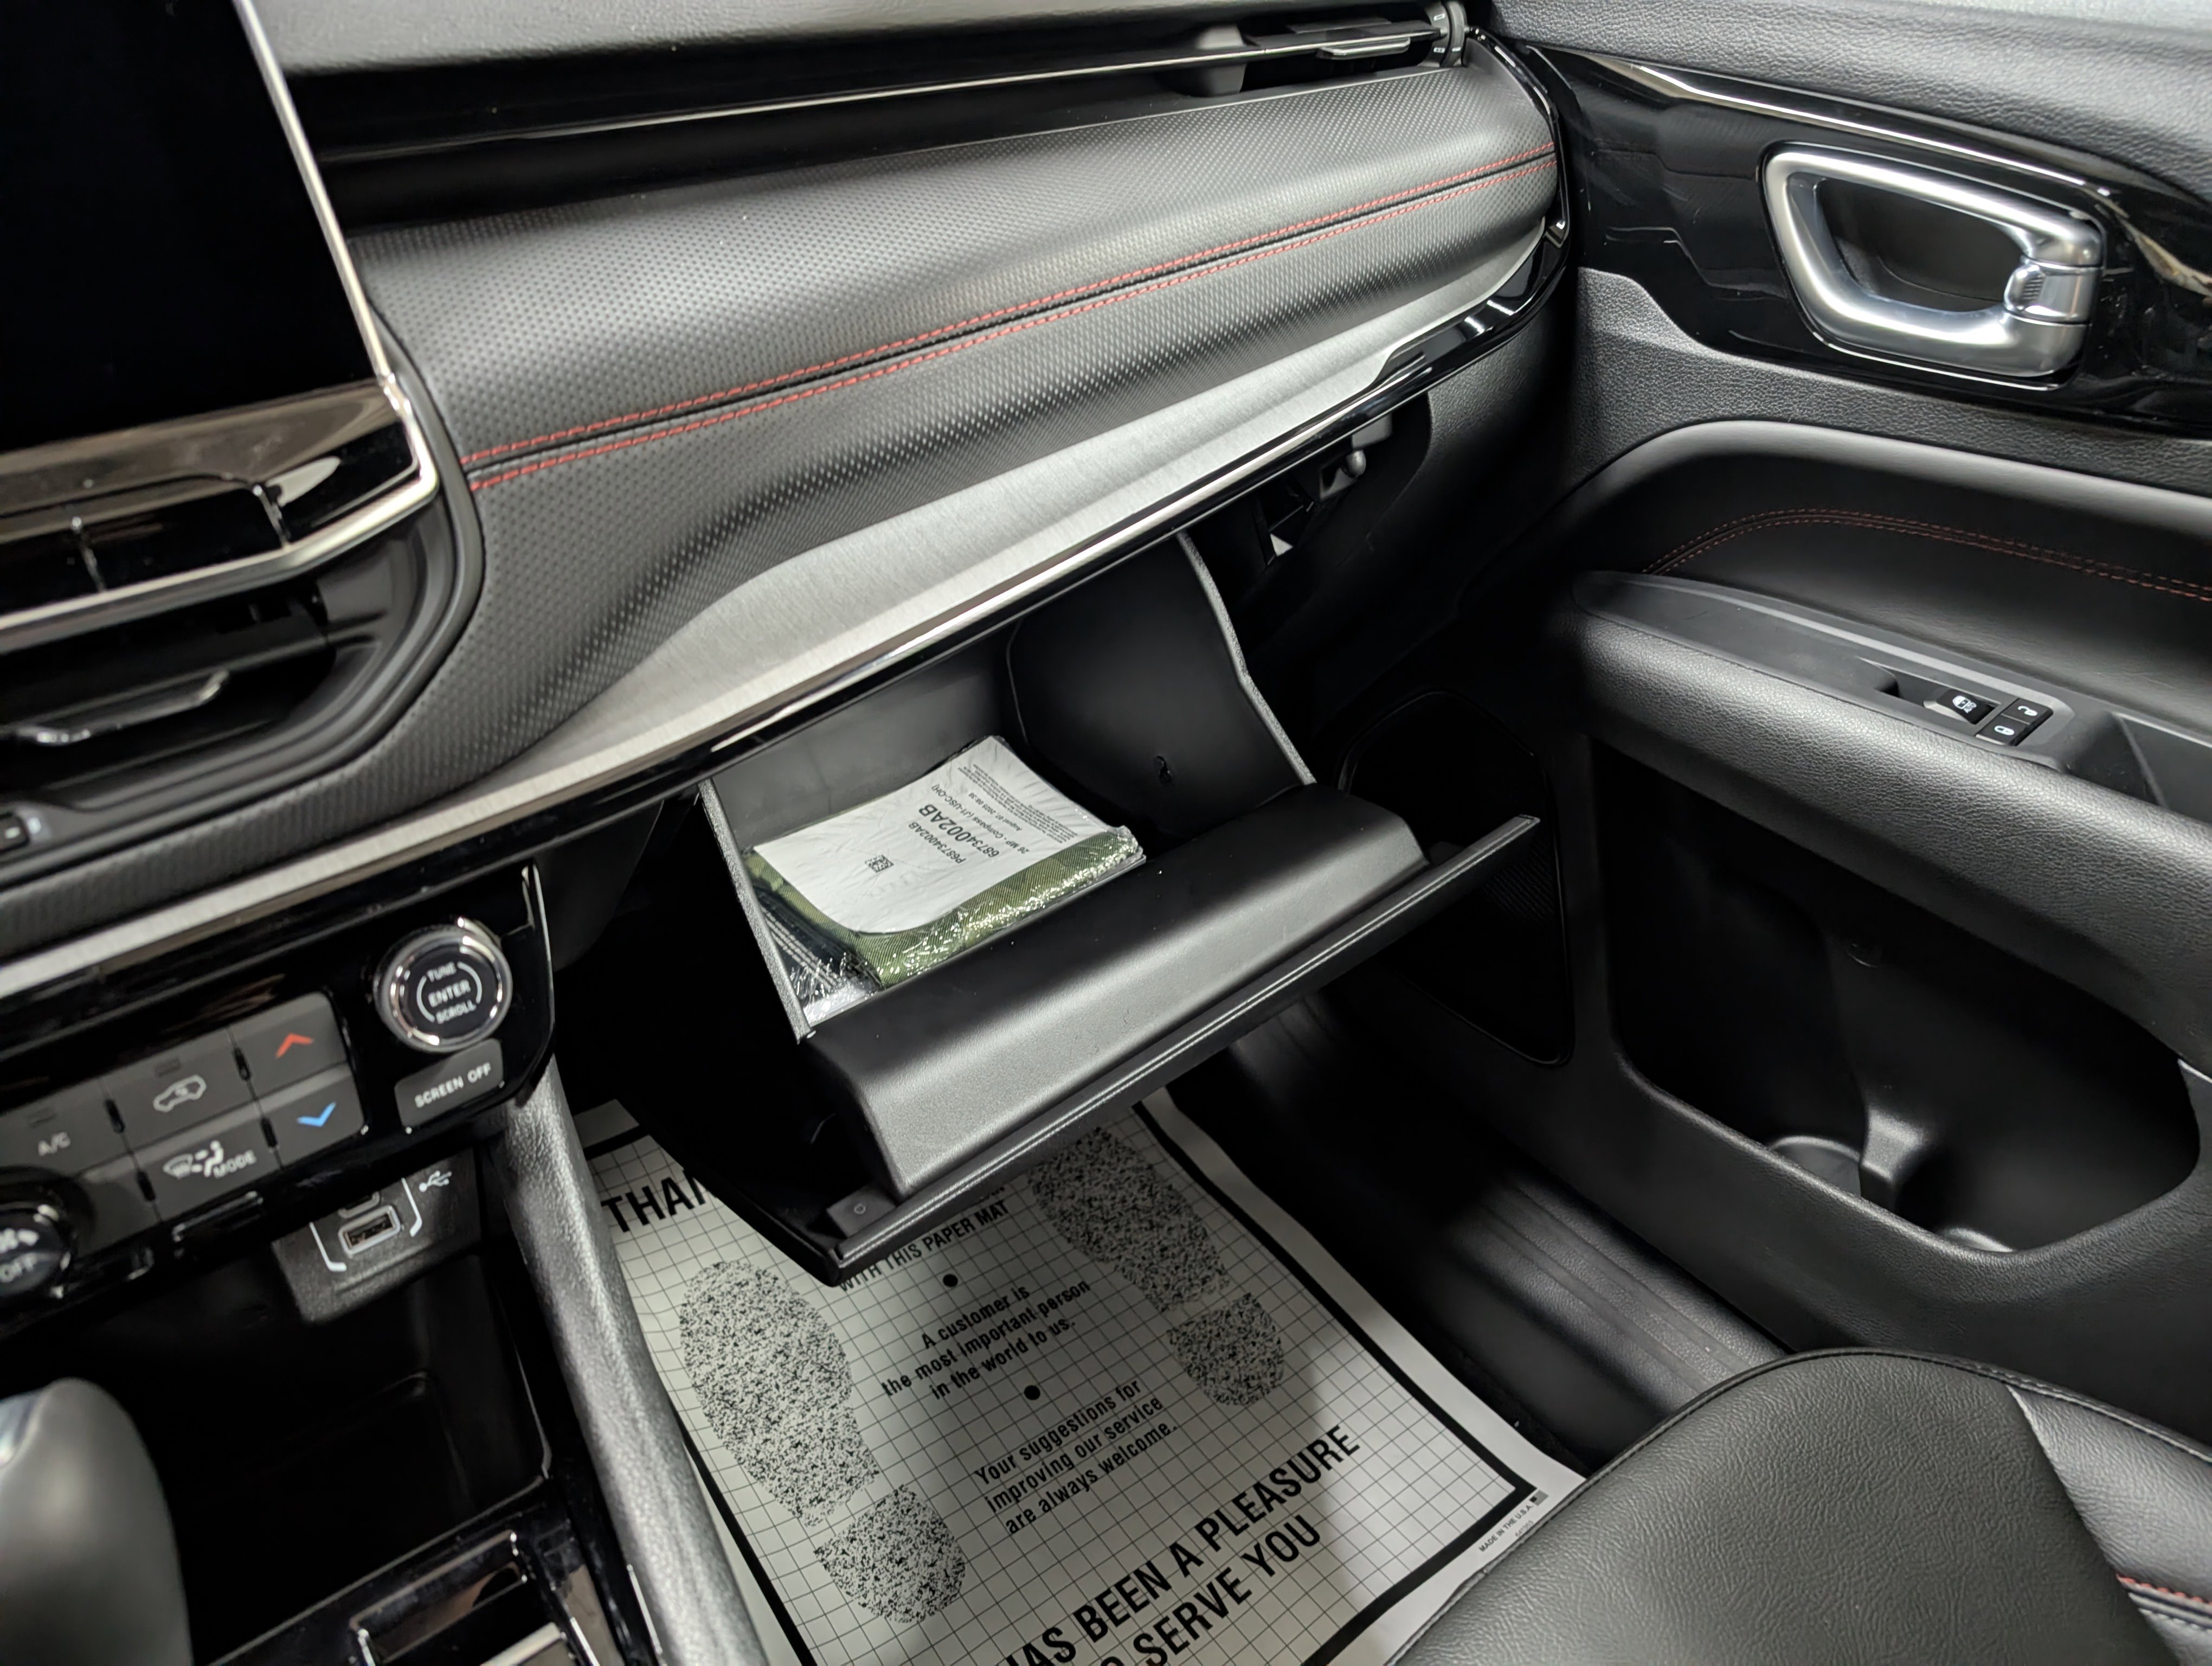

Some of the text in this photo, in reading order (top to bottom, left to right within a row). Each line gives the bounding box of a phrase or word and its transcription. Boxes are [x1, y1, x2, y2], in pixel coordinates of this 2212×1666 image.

[909, 822, 967, 864] P68734002AB
[918, 804, 1000, 857] 68734002AB
[972, 816, 1004, 839] Compass
[1002, 818, 1023, 831] August
[1005, 841, 1020, 850] MP
[427, 962, 457, 982] TUNE
[428, 979, 471, 1007] ENTER
[436, 999, 477, 1024] SCROLL
[415, 1062, 491, 1107] SCREEN OFF
[38, 1132, 70, 1156] A/C
[214, 1150, 256, 1178] MODE
[885, 1244, 922, 1270] THIS
[922, 1218, 975, 1252] PAPER
[975, 1200, 1008, 1226] MAT
[882, 1280, 1090, 1396] the most important person
[922, 1286, 1030, 1349] A customer is
[930, 1318, 1075, 1400] in the world to us.
[975, 1380, 1141, 1485] Your suggestions for
[984, 1397, 1163, 1513] improving our service
[1006, 1422, 1177, 1534] are always welcome.
[1005, 1425, 1360, 1666] AS BEEN A PLEASURE
[1478, 1535, 1498, 1552] MADE
[1496, 1529, 1505, 1537] IN
[1503, 1518, 1517, 1529] THE
[1133, 1514, 1320, 1666] SERVE YOU
